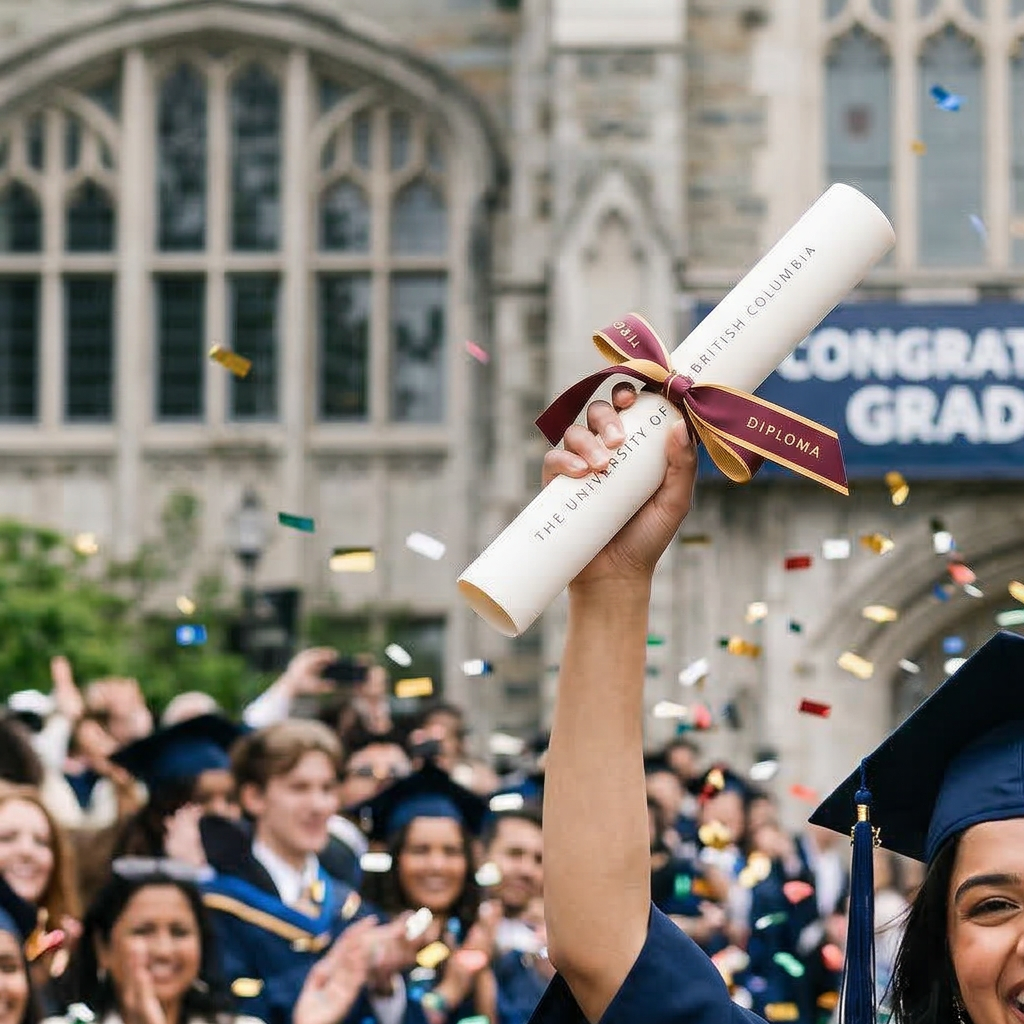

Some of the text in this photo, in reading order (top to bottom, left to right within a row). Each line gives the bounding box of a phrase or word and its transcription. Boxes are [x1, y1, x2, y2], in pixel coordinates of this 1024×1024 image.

[534, 512, 565, 541] THE
[649, 405, 669, 426] OF
[690, 317, 746, 374] BRITISH
[746, 246, 817, 317] COLUMBIA
[746, 416, 821, 459] DIPLOMA
